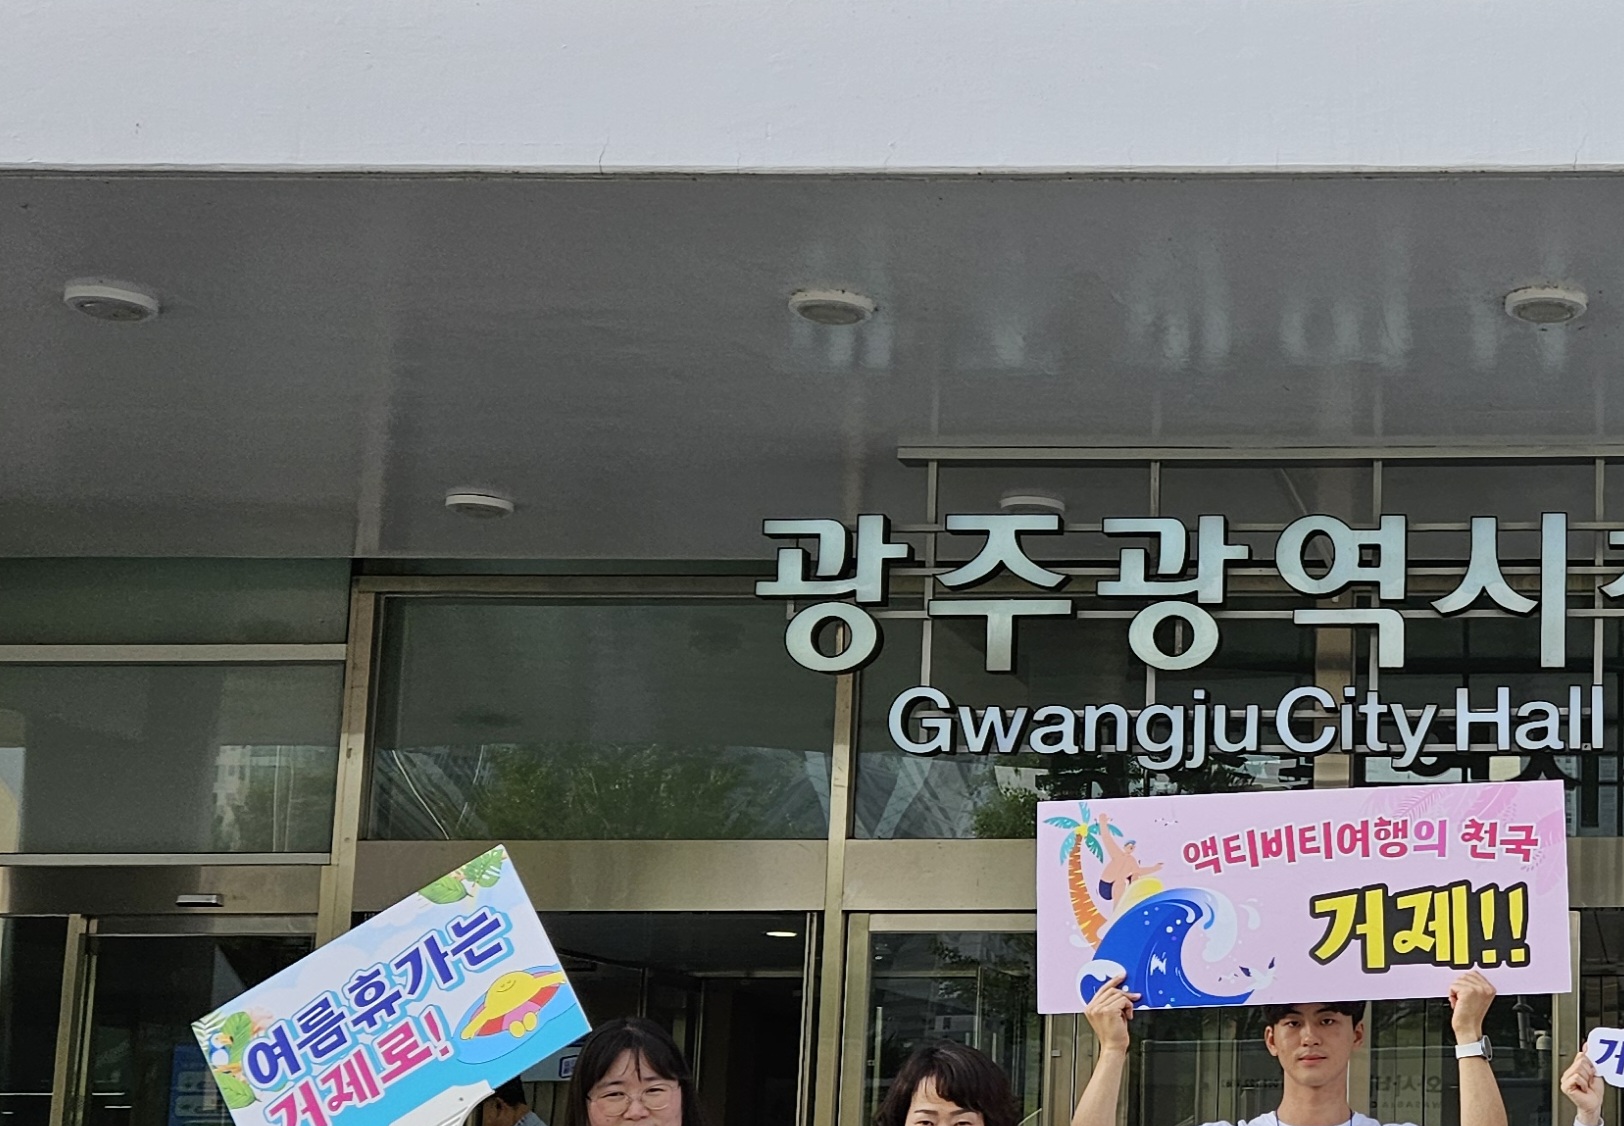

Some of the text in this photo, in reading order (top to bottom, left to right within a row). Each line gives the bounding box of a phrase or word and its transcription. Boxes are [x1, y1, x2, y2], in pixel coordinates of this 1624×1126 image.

[888, 684, 1604, 772] Gwangju City Hall
[1182, 816, 1539, 874] 액티비티여행의 천국
[1308, 880, 1532, 971] 거제!!
[246, 911, 504, 1087] 여름휴가는
